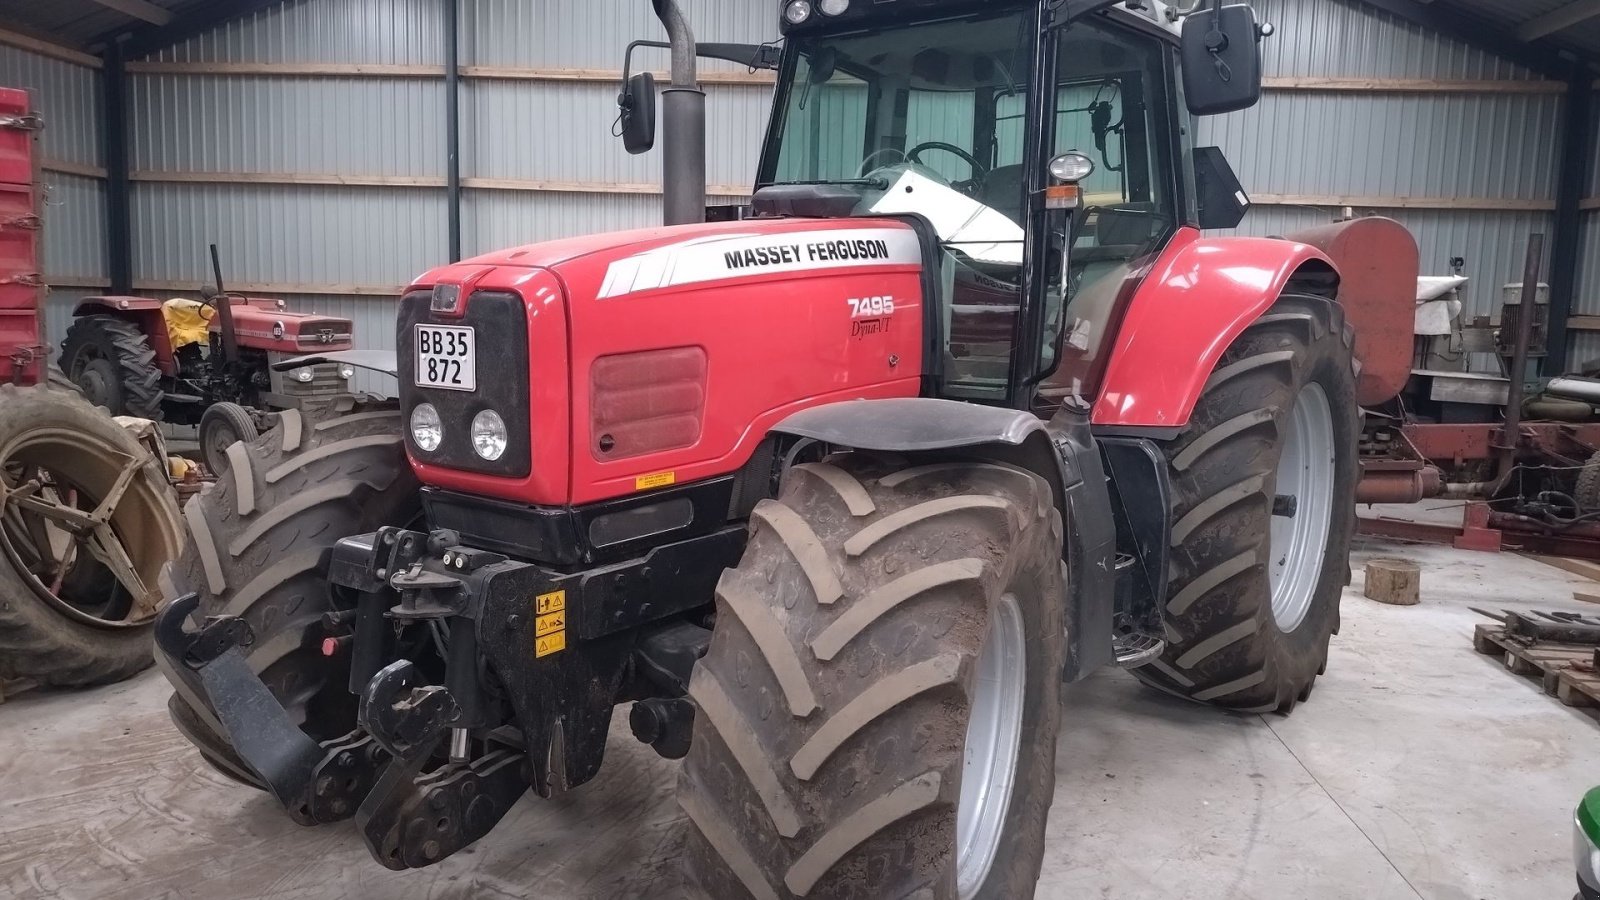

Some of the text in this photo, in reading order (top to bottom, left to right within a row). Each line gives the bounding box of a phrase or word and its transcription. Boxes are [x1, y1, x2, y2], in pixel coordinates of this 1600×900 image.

[724, 240, 889, 269] MASSEY FERGUSON
[847, 295, 895, 318] 7495
[428, 357, 462, 385] 872
